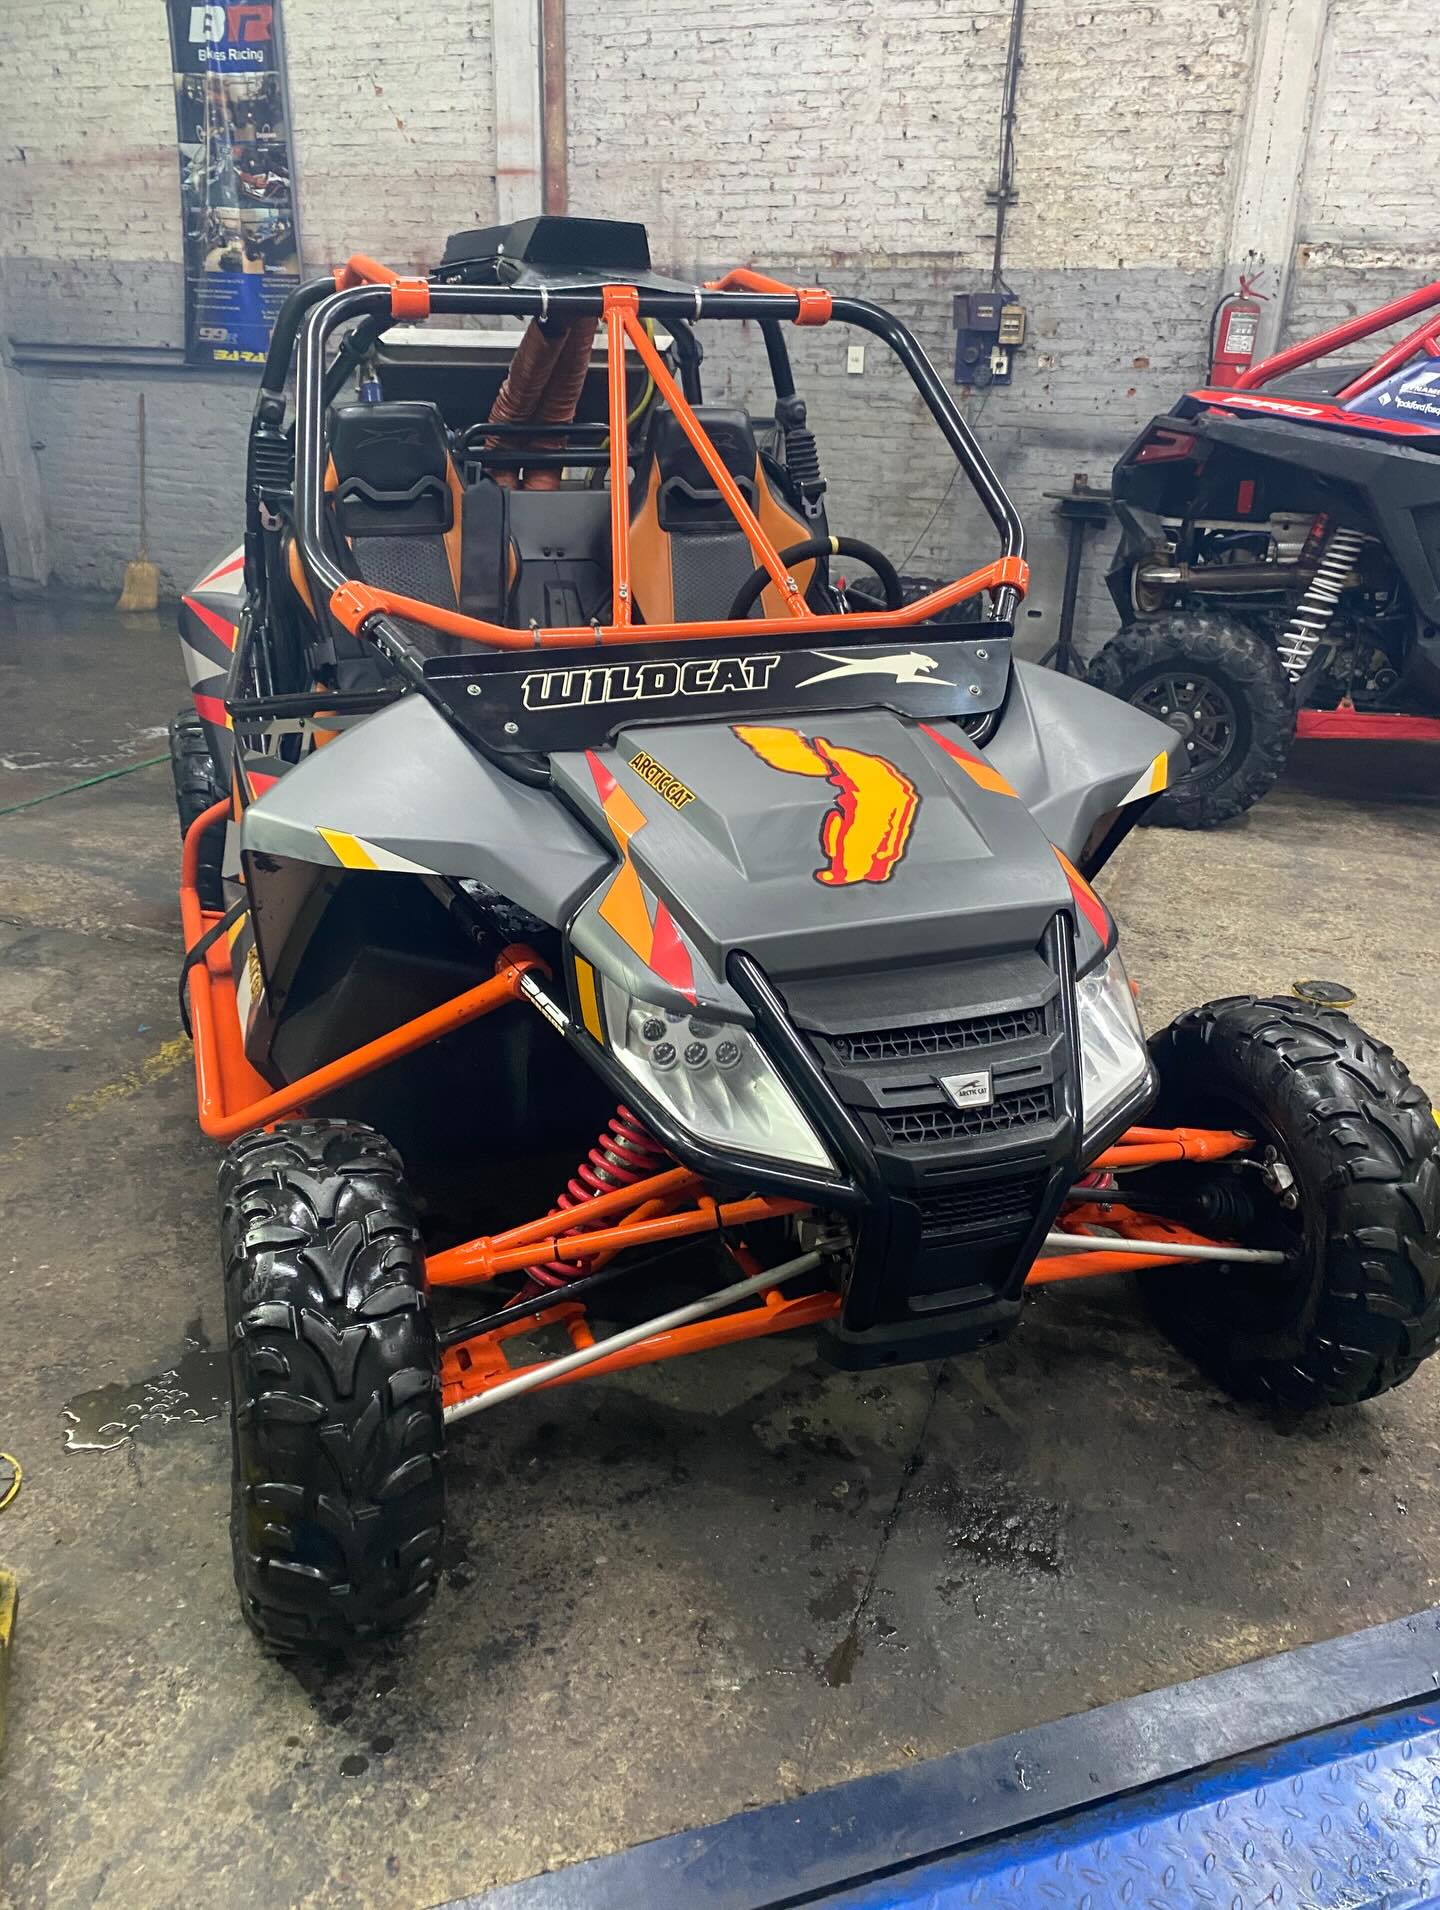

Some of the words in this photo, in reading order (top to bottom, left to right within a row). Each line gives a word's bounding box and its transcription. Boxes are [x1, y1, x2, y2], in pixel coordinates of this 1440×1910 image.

[228, 48, 264, 62] Racing
[1223, 396, 1324, 416] PRO
[521, 656, 781, 710] WILDCAT
[629, 752, 673, 792] ARCTIC
[665, 782, 695, 809] CAT
[959, 1089, 978, 1097] ARCTIC
